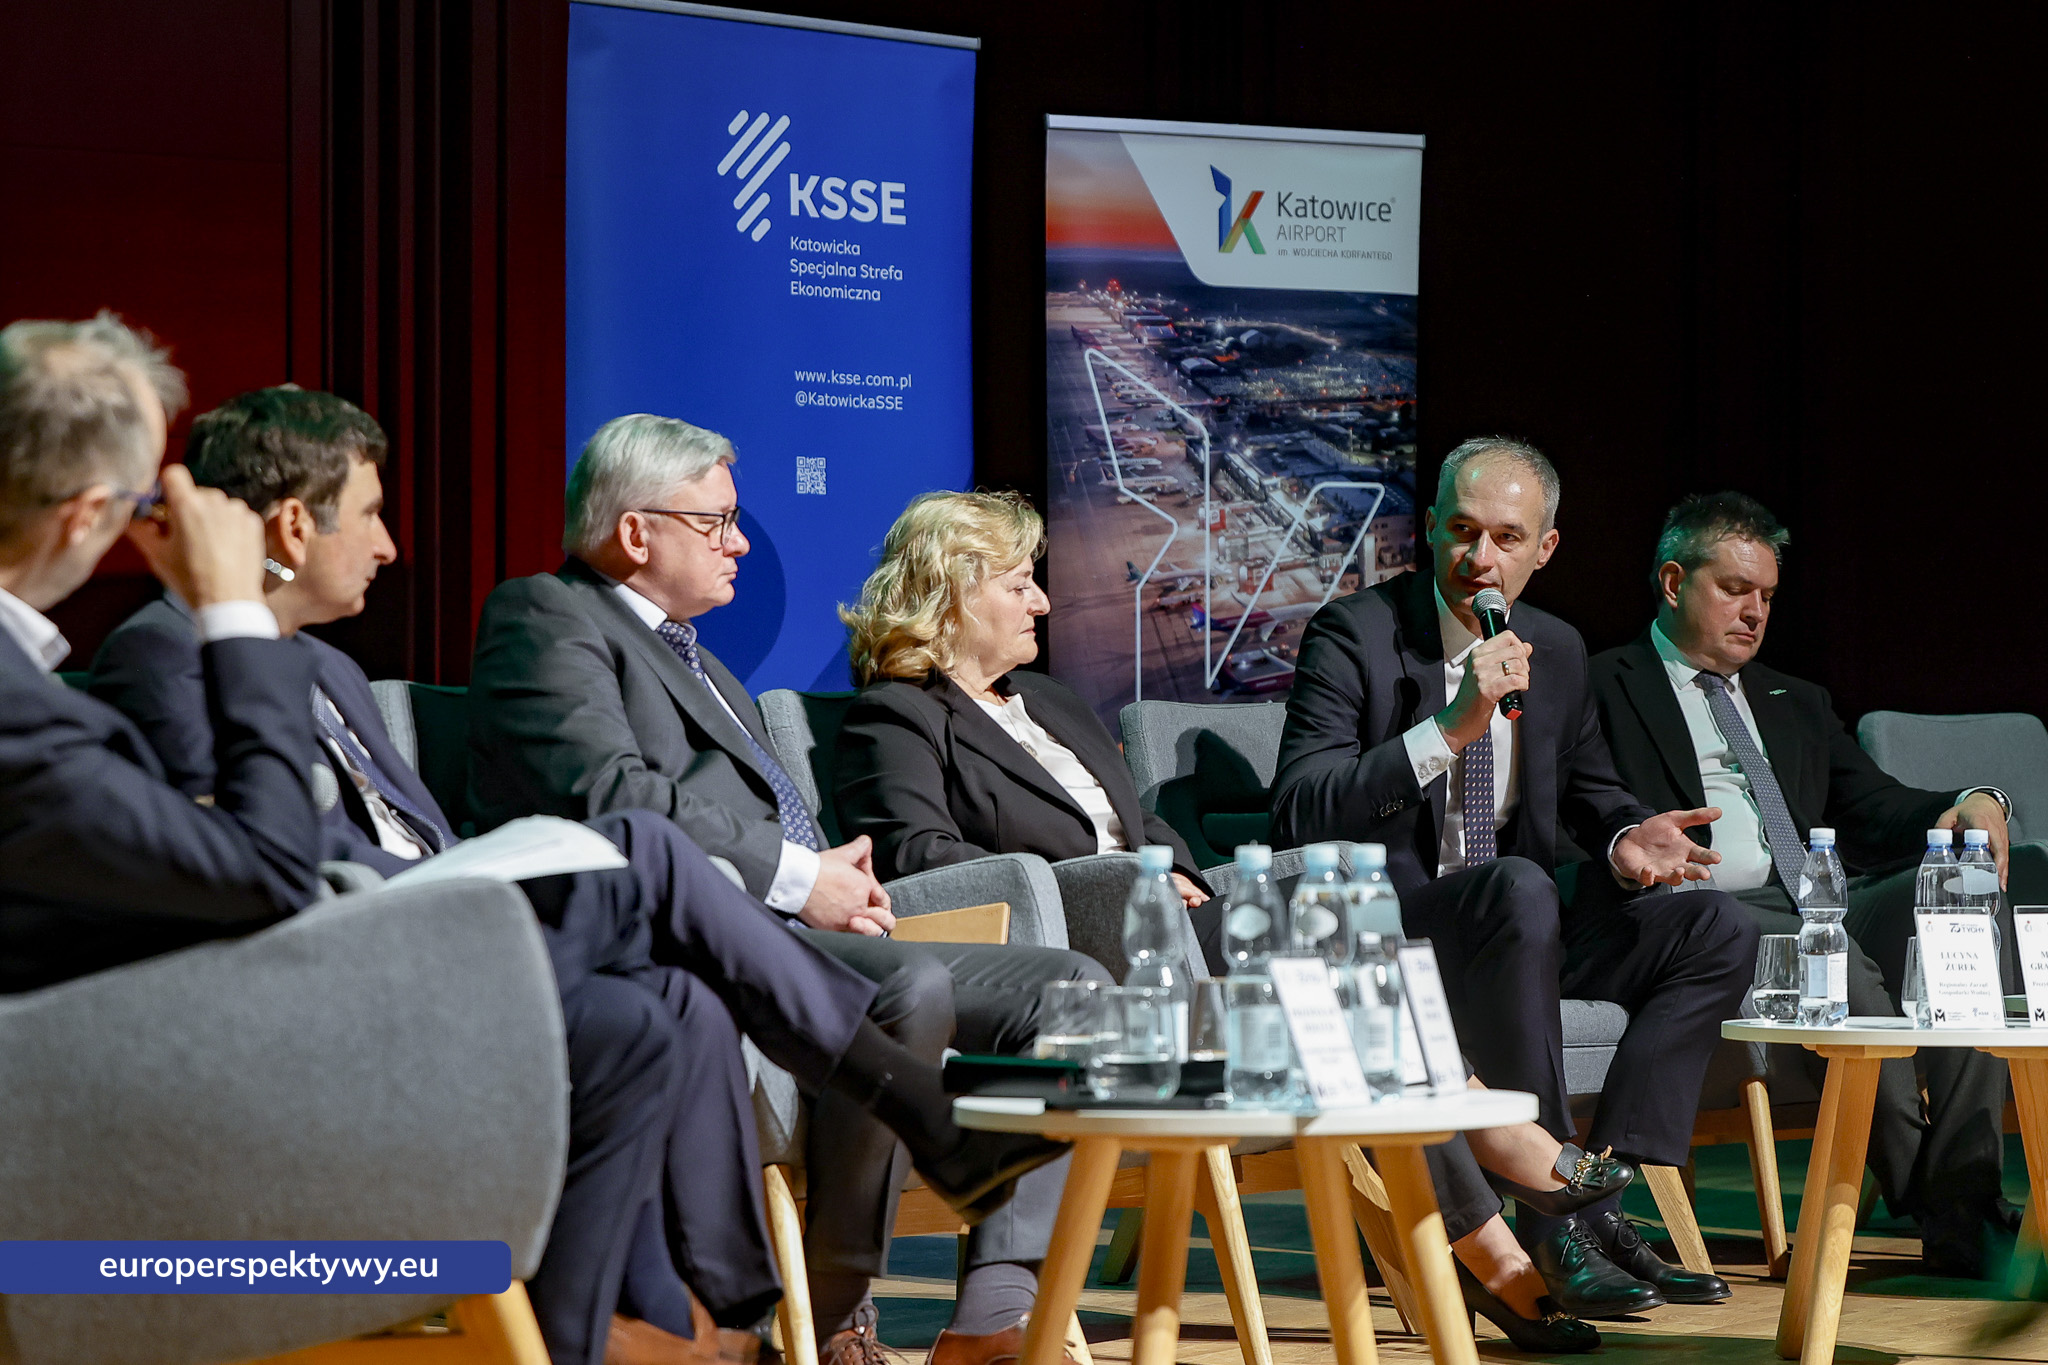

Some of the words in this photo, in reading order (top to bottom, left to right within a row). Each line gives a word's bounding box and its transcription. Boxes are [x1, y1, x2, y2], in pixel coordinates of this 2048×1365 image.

[789, 173, 907, 225] KSSE
[1277, 191, 1392, 222] Katowice
[1276, 224, 1346, 243] AIRPORT
[790, 236, 861, 255] Katowicka
[1293, 247, 1339, 258] WOJCIECHA
[1341, 250, 1393, 261] KORFANTEGO
[790, 258, 857, 279] Specjalna
[860, 264, 903, 280] Strefa
[790, 281, 881, 301] Ekonomiczna
[795, 369, 912, 390] www.ksse.com.pl
[795, 391, 904, 410] @KatowickaSSE
